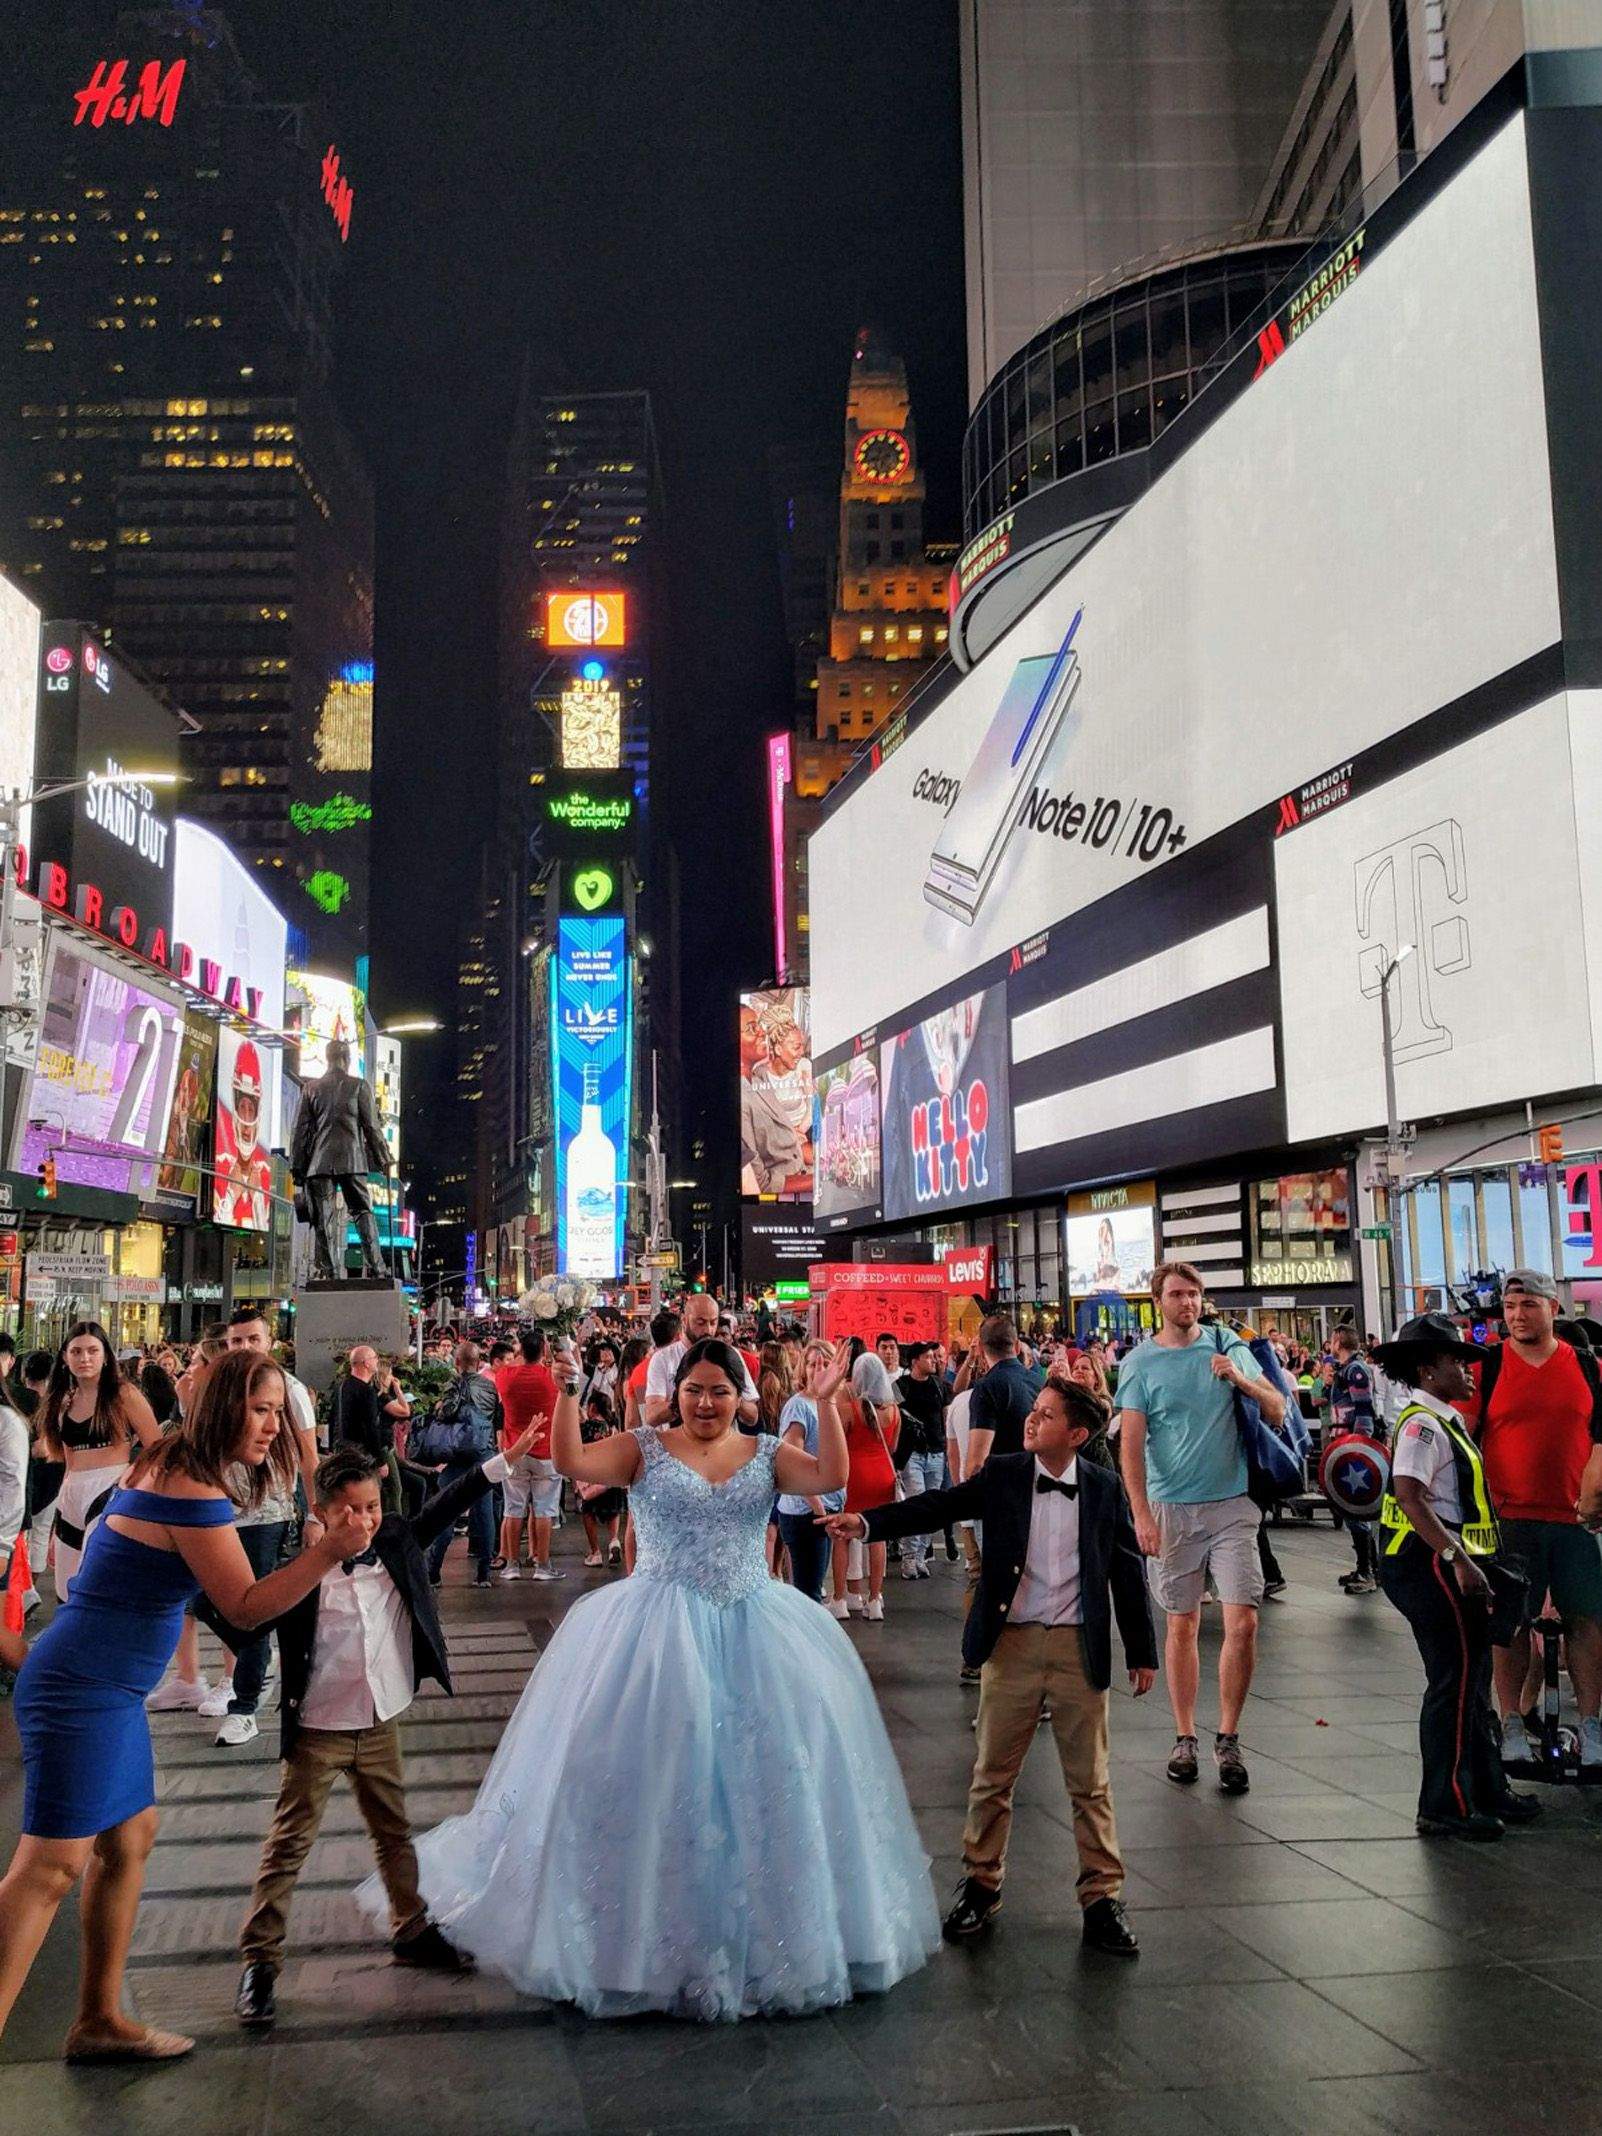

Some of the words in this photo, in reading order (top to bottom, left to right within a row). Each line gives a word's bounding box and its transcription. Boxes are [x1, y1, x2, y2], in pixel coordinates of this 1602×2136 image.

[73, 59, 187, 128] H&M
[1290, 228, 1366, 319] MARRIOTT
[1291, 264, 1357, 341] MARQUIS
[960, 512, 1016, 574] MARRIOTT
[961, 540, 1007, 593] MARQUIS
[47, 677, 70, 691] LG
[95, 658, 110, 683] LG
[572, 679, 610, 692] 2019
[139, 784, 153, 810] TO
[570, 792, 590, 805] the
[912, 767, 962, 819] Galaxy
[1302, 764, 1355, 801] MARRIOTT
[86, 770, 136, 846] STAND
[550, 801, 631, 817] Wonderful
[1302, 784, 1349, 816] MARQUIS
[138, 811, 167, 868] OUT
[570, 817, 622, 830] company
[41, 861, 264, 1018] BROADWAY
[573, 962, 611, 970] SUMMER
[565, 1001, 618, 1026] LIVE
[911, 1078, 989, 1154] HELLO
[914, 1131, 989, 1202] KITTY
[1091, 1187, 1129, 1210] INVICTA
[752, 1226, 799, 1234] UNIVERSAL
[1252, 1260, 1349, 1286] SEPHORA
